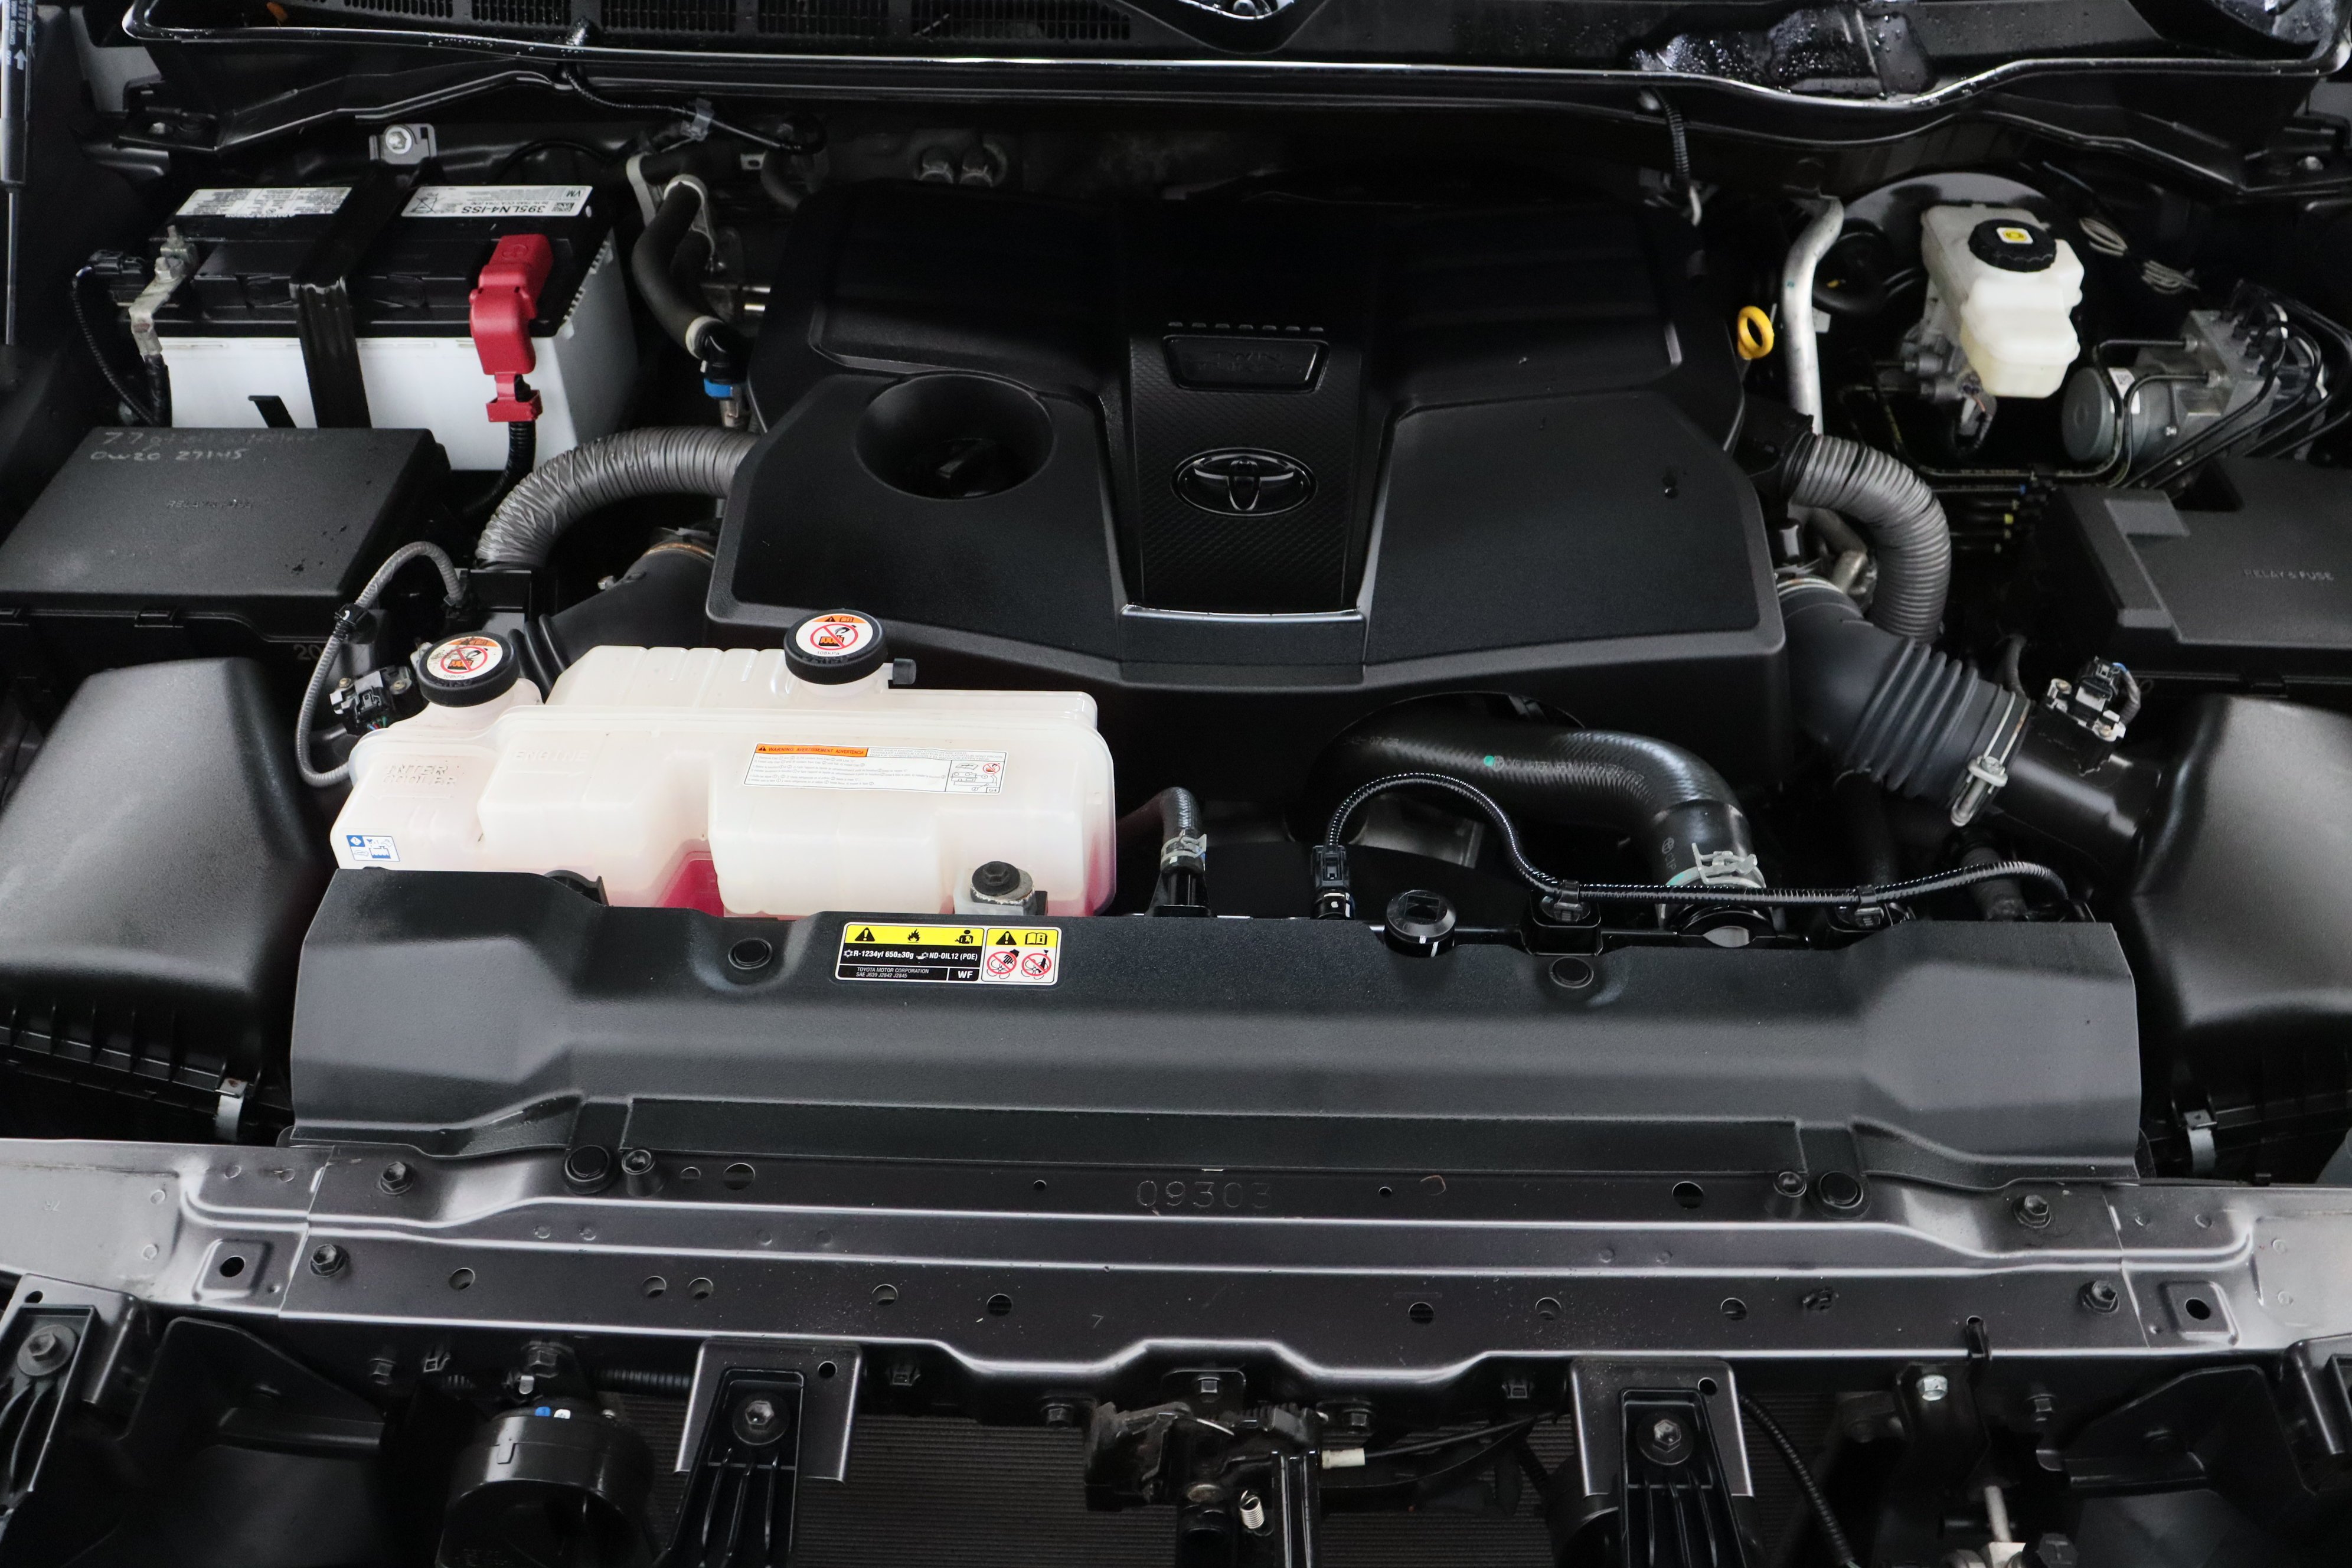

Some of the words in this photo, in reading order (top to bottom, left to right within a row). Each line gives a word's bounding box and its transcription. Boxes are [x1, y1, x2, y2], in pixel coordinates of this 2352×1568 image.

[461, 204, 546, 214] 395LN4-ISS
[514, 750, 589, 762] ENGINE
[387, 764, 447, 775] INTER
[383, 775, 457, 786] COOLER
[853, 950, 884, 959] R-1234yf
[885, 951, 914, 959] 650±30g
[929, 952, 959, 960] ND-OIL12
[960, 953, 978, 961] (POE)
[958, 971, 974, 979] WF
[1136, 1180, 1272, 1208] 09303
